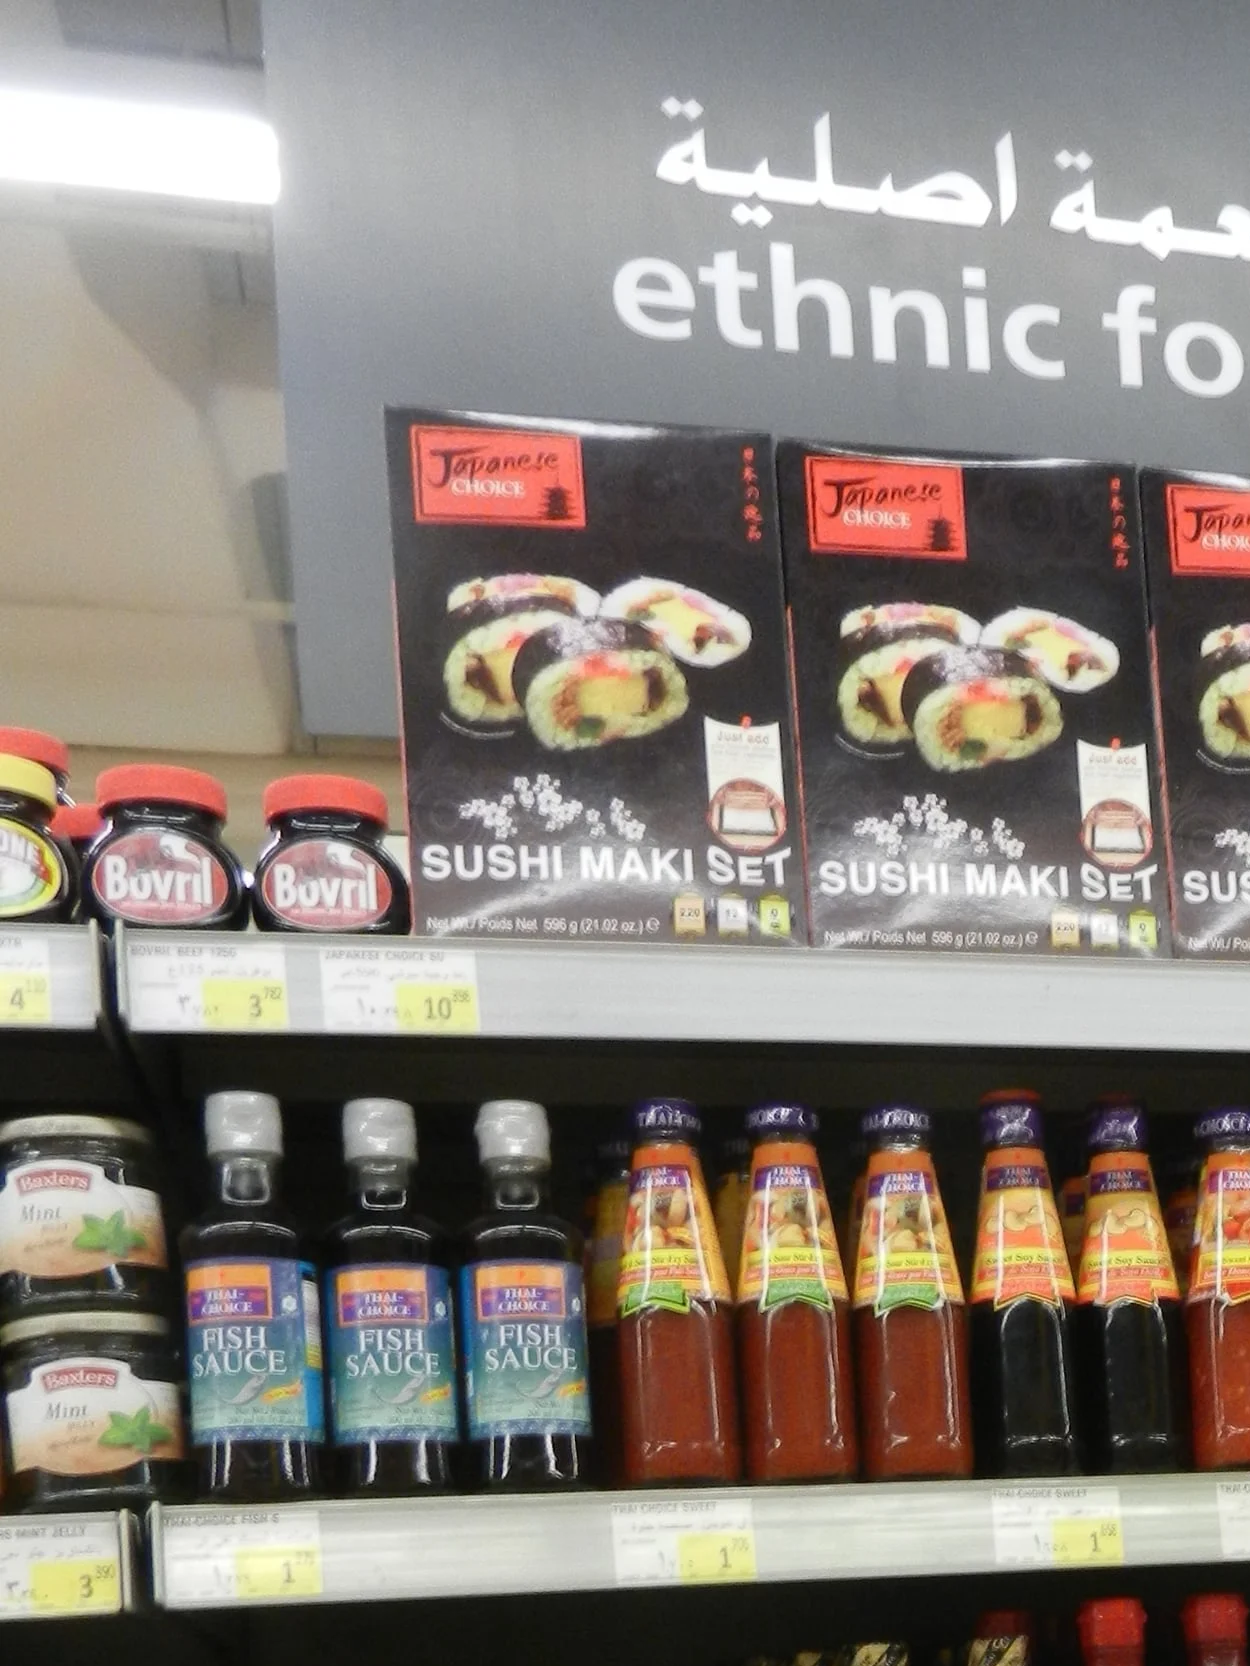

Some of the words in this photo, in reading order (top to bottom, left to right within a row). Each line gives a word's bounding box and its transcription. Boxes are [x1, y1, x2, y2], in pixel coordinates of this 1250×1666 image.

[656, 95, 1018, 229] اصلية
[611, 243, 1066, 377] ethnic
[451, 477, 525, 499] CHOICE
[844, 509, 911, 529] CHOICE
[421, 843, 563, 883] SUSHI
[579, 846, 694, 885] MAKI
[708, 847, 793, 888] SET
[104, 855, 214, 908] Bovril
[273, 862, 379, 912] Bovril
[819, 861, 949, 897] SUSHI
[964, 866, 1068, 899] MAKI
[1081, 864, 1158, 902] SET
[249, 995, 263, 1019] 3
[19, 1170, 91, 1191] Baxters
[19, 1204, 62, 1224] Mint
[201, 1325, 268, 1351] FISH
[359, 1329, 426, 1353] FISH
[499, 1323, 562, 1348] FISH
[192, 1350, 288, 1380] SAUCE
[346, 1353, 441, 1379] SAUCE
[484, 1347, 578, 1373] SAUCE
[43, 1368, 118, 1390] Baxters
[44, 1403, 90, 1423] Mint
